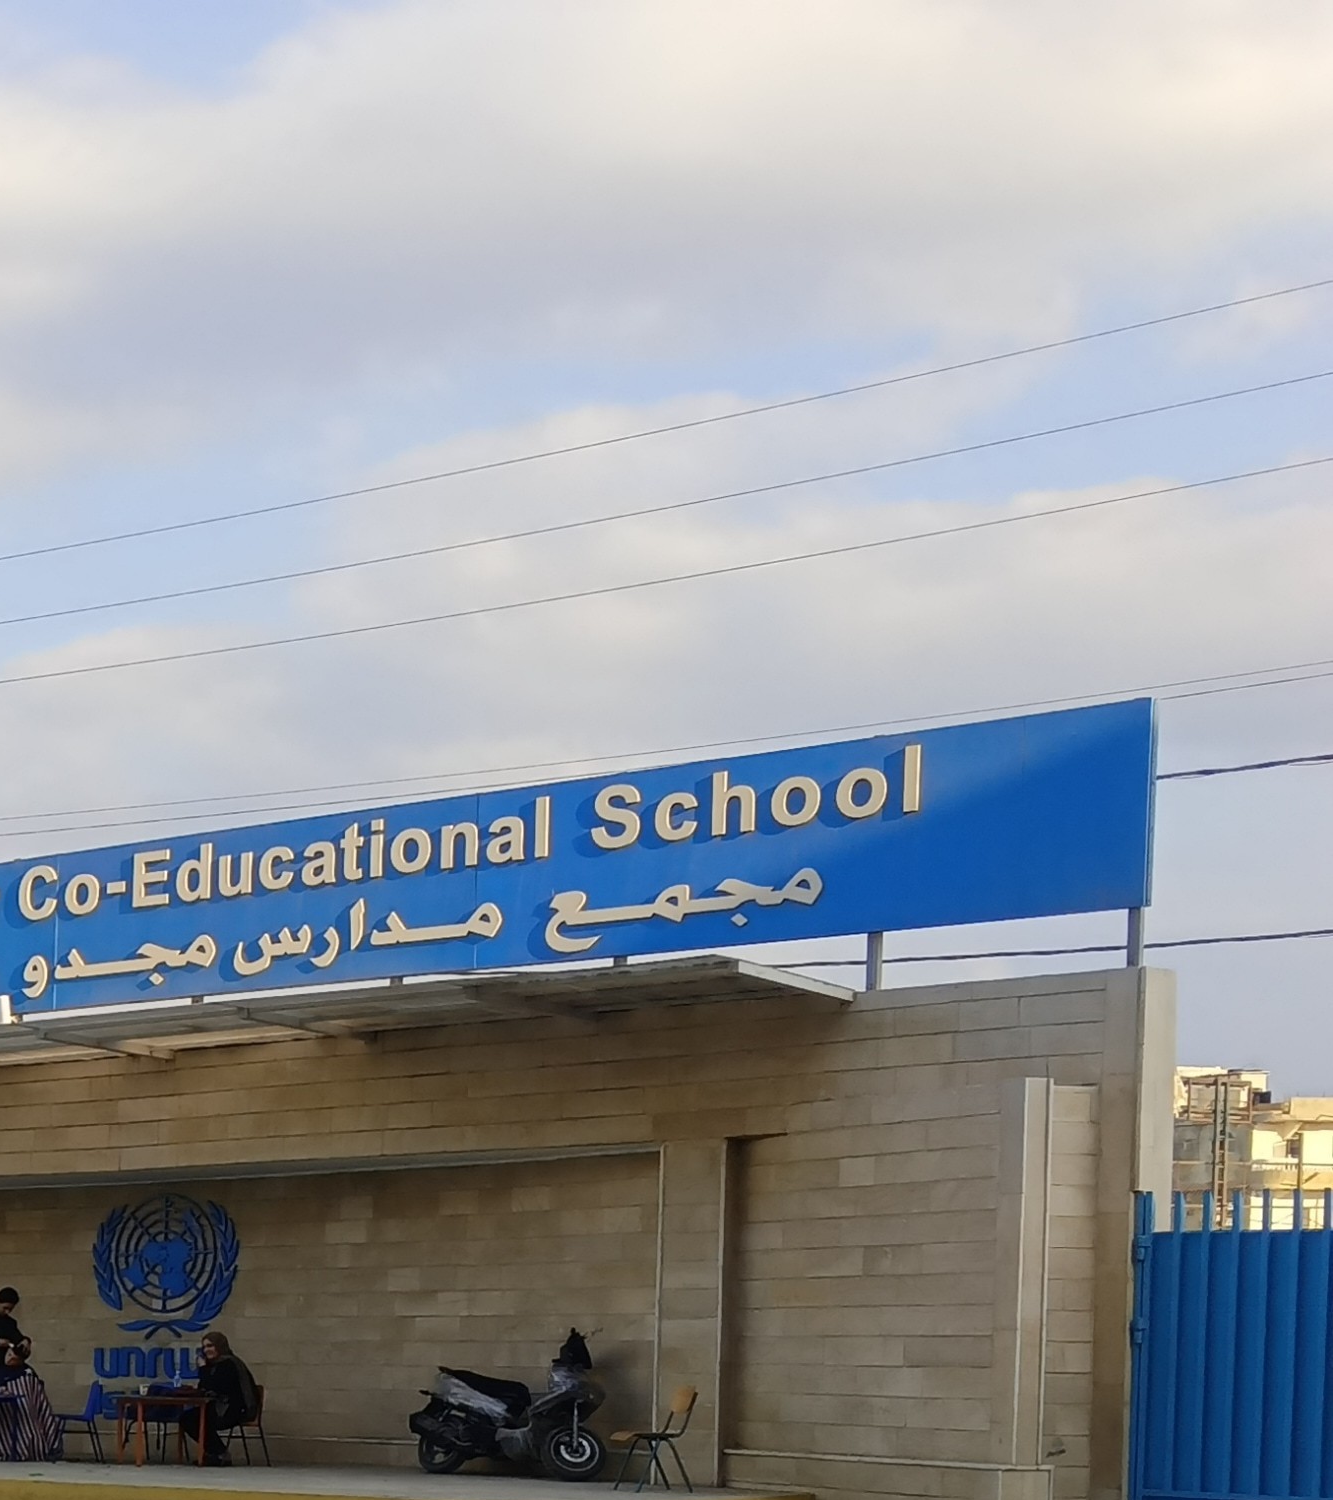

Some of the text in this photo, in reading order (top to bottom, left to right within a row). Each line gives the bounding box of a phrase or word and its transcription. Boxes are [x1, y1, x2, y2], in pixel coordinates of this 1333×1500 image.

[18, 796, 551, 921] Co-Educational
[591, 743, 923, 849] School
[234, 898, 504, 976] مدارس
[545, 867, 824, 953] مجمع
[21, 934, 217, 998] مجدو
[94, 1346, 202, 1379] unrw
